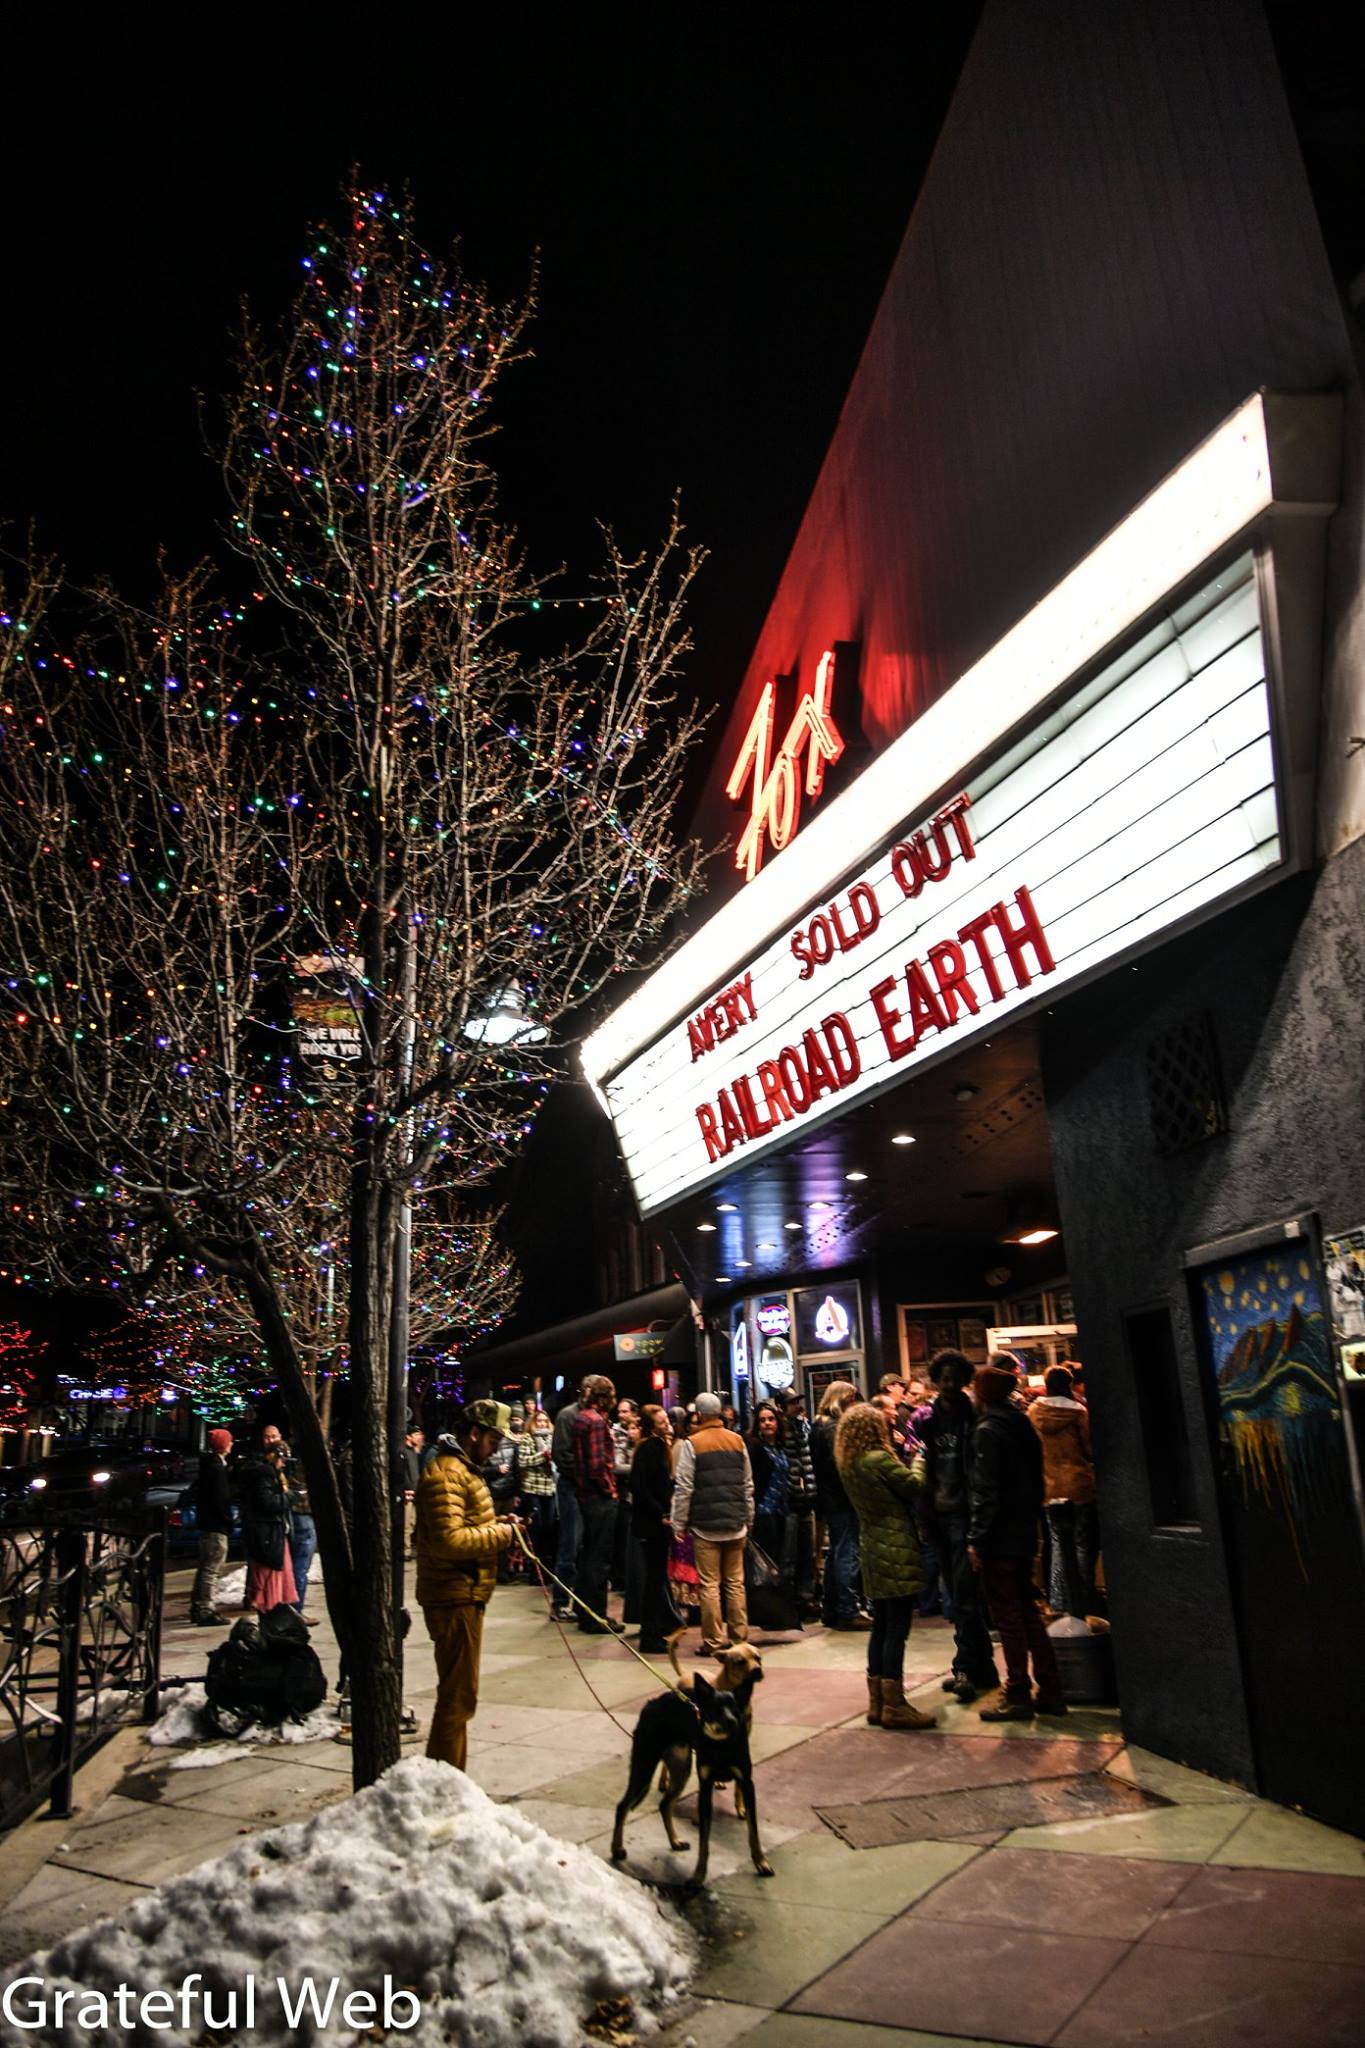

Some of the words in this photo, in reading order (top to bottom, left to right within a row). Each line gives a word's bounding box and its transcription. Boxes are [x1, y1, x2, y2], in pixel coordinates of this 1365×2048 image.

[688, 972, 757, 1063] AVERY
[791, 881, 881, 981] SOLD
[891, 792, 978, 899] OUT
[694, 1011, 861, 1164] RAILROAD
[869, 885, 1056, 1062] EARTH
